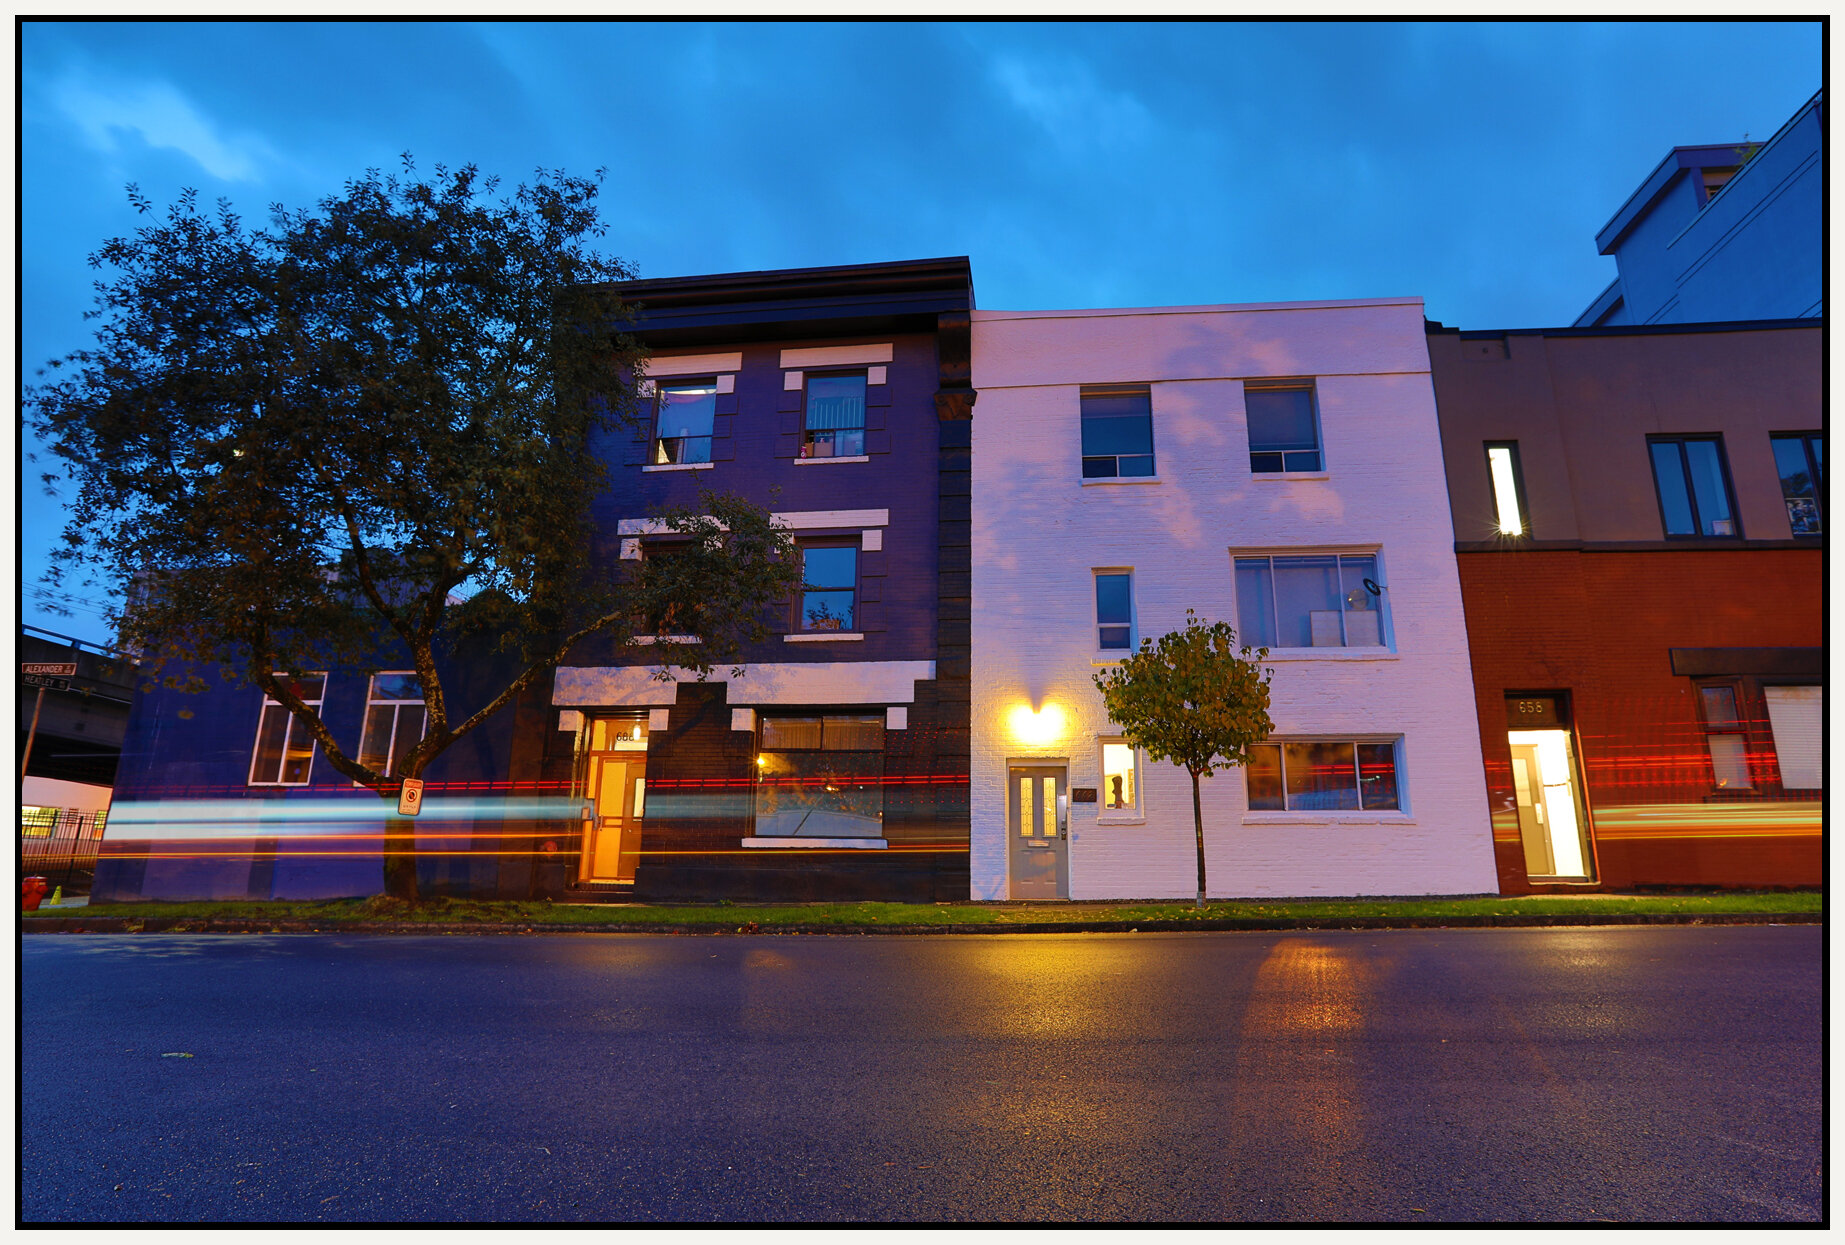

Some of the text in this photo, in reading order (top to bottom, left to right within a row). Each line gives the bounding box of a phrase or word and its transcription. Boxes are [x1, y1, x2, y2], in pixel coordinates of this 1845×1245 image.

[25, 665, 63, 673] ALEXANDER
[24, 675, 55, 687] HEATLEY
[1519, 701, 1543, 713] 658
